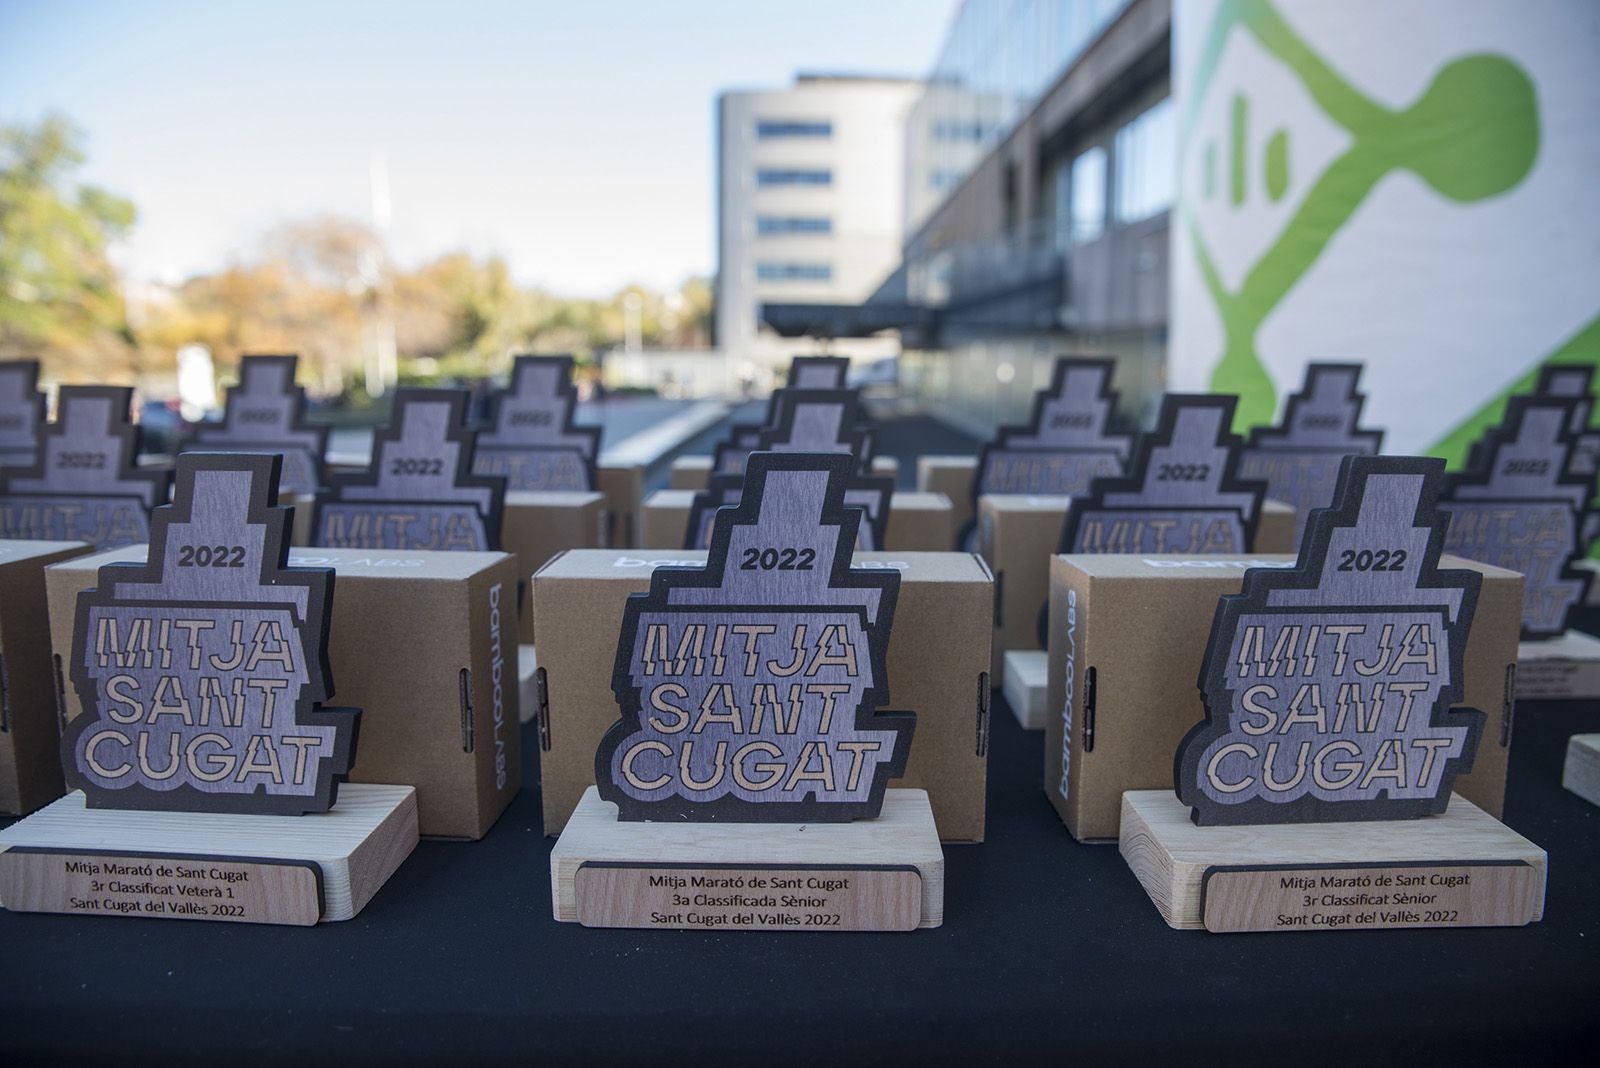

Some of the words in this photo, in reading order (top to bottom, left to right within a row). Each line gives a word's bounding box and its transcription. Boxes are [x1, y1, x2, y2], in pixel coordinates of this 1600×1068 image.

[391, 458, 445, 477] 2022
[1156, 463, 1211, 482] 2022
[326, 511, 477, 550] MITJA
[1081, 519, 1236, 553] MITJA
[178, 546, 246, 567] 2022
[741, 548, 816, 571] 2022
[1337, 549, 1407, 572] 2022
[96, 617, 295, 672] MITJA
[641, 624, 858, 677] MITJA
[1237, 624, 1438, 678] MITJA
[105, 674, 289, 728] SANT
[649, 682, 851, 735] SANT
[1240, 682, 1430, 736] SANT
[85, 729, 322, 785] CUGAT
[621, 740, 882, 792] CUGAT
[1207, 738, 1453, 794] CUGAT
[65, 862, 100, 876] Mitja
[103, 863, 152, 876] Marató
[156, 865, 173, 877] de
[177, 866, 207, 879] Sant
[210, 868, 248, 882] Cugat
[650, 876, 686, 889] Mitja
[691, 876, 744, 889] Marató
[748, 877, 767, 889] de
[770, 878, 802, 889] Sant
[806, 878, 849, 891] Cugat
[1280, 877, 1316, 891] Mitja
[1320, 876, 1371, 888] Marató
[1375, 875, 1392, 887] de
[1395, 875, 1426, 887] Sant
[1430, 874, 1470, 888] Cugat
[91, 881, 105, 892] 3r
[109, 881, 174, 895] Classificat
[177, 884, 222, 898] Veterà
[227, 888, 235, 899] 1
[673, 894, 690, 906] 3a
[694, 894, 777, 907] Classificada
[781, 895, 827, 908] Sènior
[1302, 896, 1318, 907] 3r
[1321, 894, 1389, 906] Classificat
[1392, 893, 1437, 905] Sènior
[70, 898, 99, 909] Sant
[103, 899, 142, 913] Cugat
[145, 901, 165, 913] del
[168, 902, 208, 915] Vallès
[212, 904, 245, 917] 2022
[1277, 914, 1308, 926] Sant
[1312, 913, 1351, 927] Cugat
[1355, 912, 1375, 924] del
[1380, 911, 1420, 923] Vallès
[1424, 911, 1458, 922] 2022
[651, 912, 682, 924] Sant
[687, 912, 727, 927] Cugat
[732, 913, 753, 924] del
[757, 913, 800, 926] Vallès
[805, 914, 841, 926] 2022
